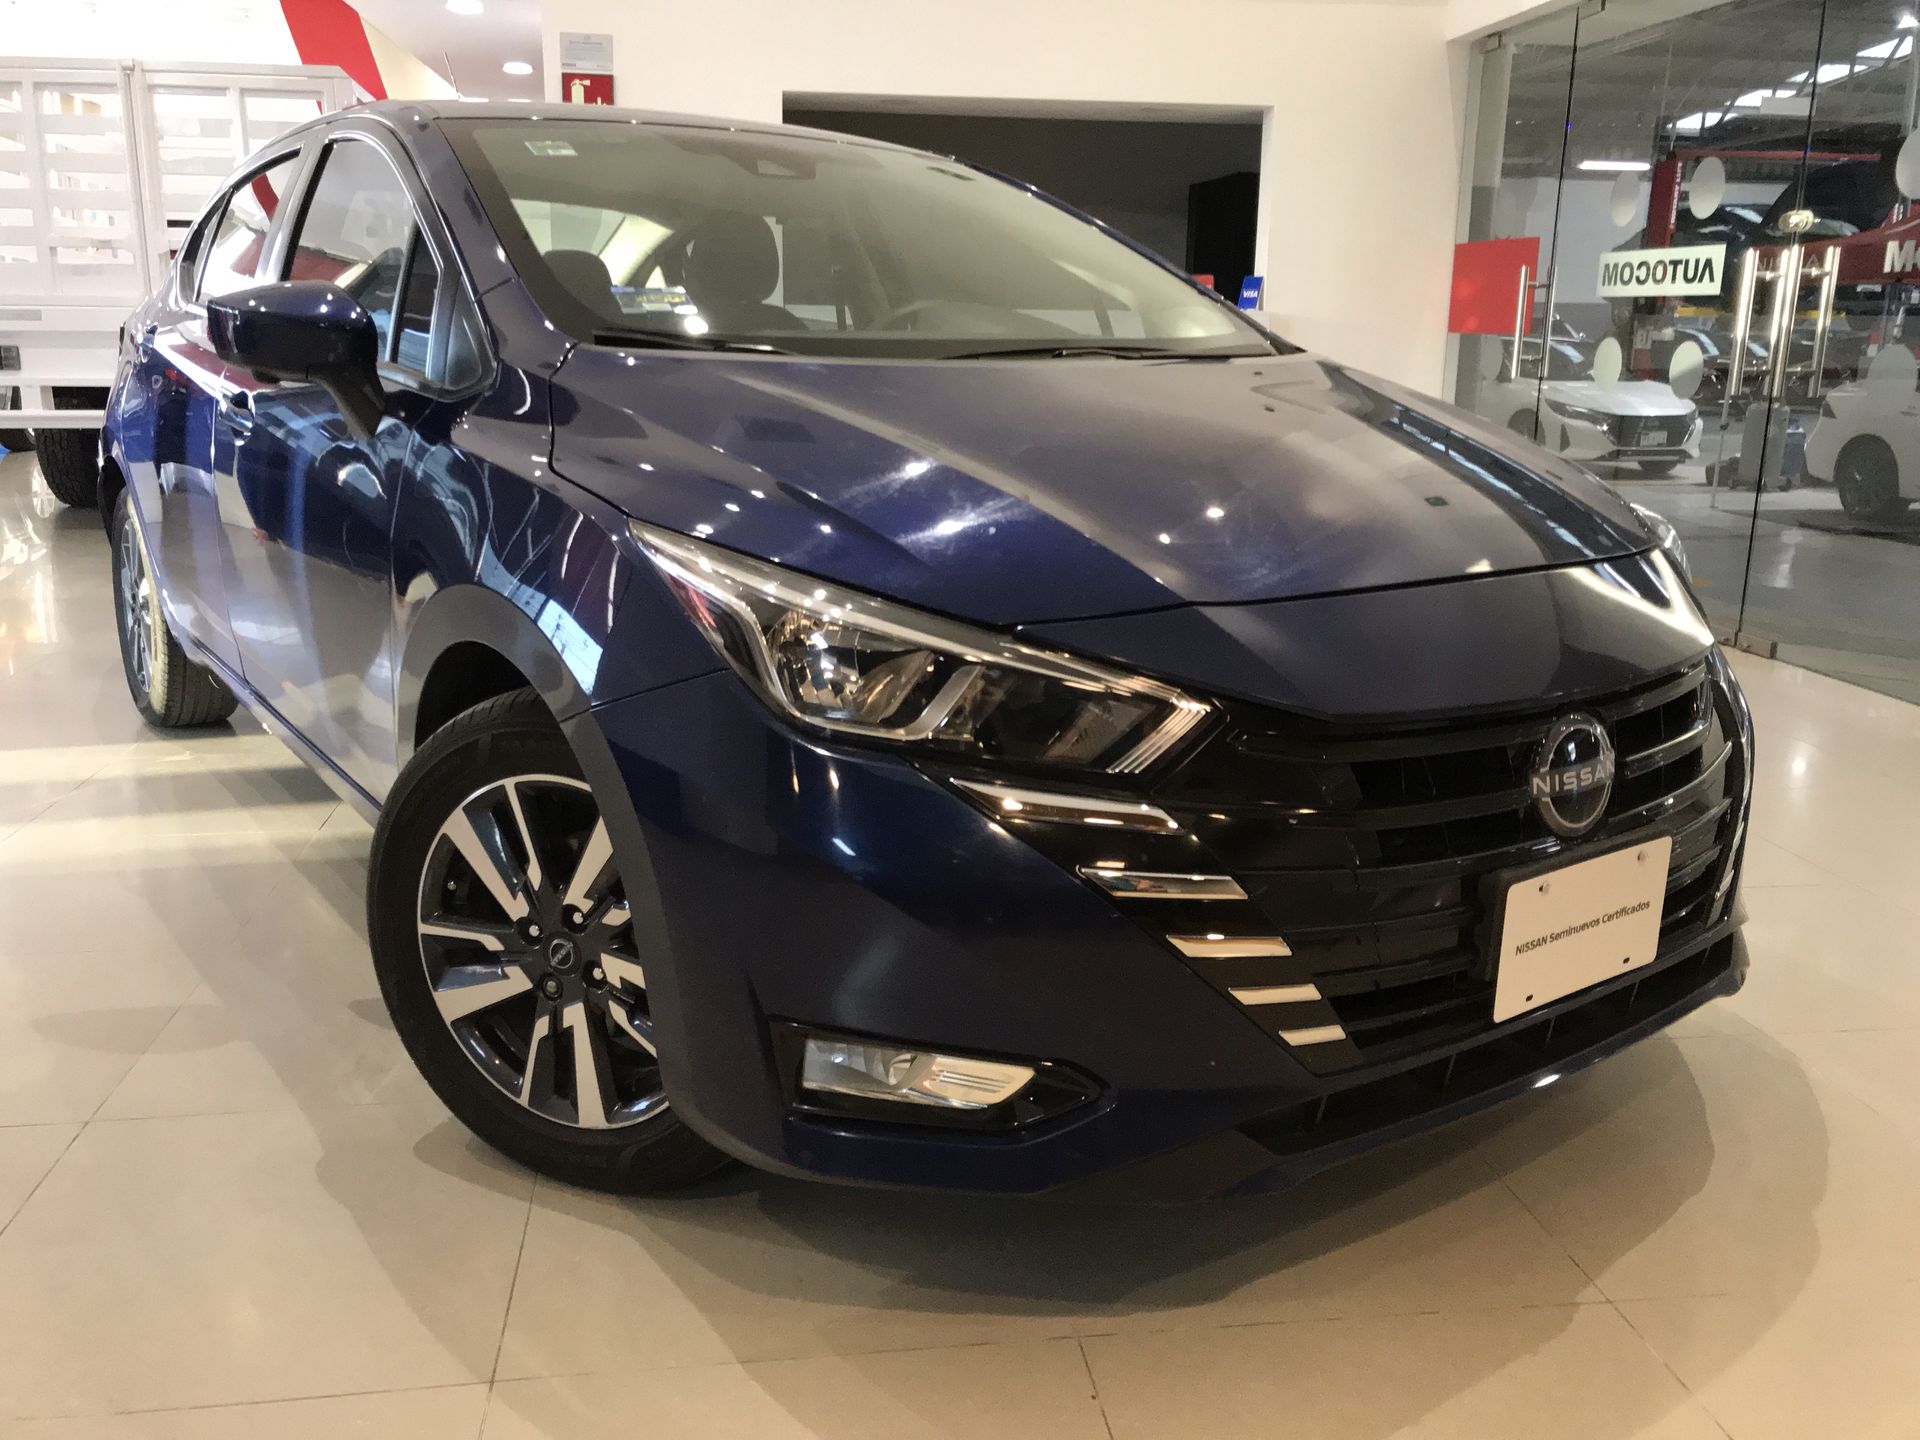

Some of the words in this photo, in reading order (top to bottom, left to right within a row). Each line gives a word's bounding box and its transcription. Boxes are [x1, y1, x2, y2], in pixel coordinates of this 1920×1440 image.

[1243, 290, 1258, 298] VISA
[1532, 756, 1615, 795] NISSAN
[1515, 935, 1547, 956] NISSAN
[1549, 918, 1600, 943] Seminuevos
[1601, 900, 1651, 924] Certificados
